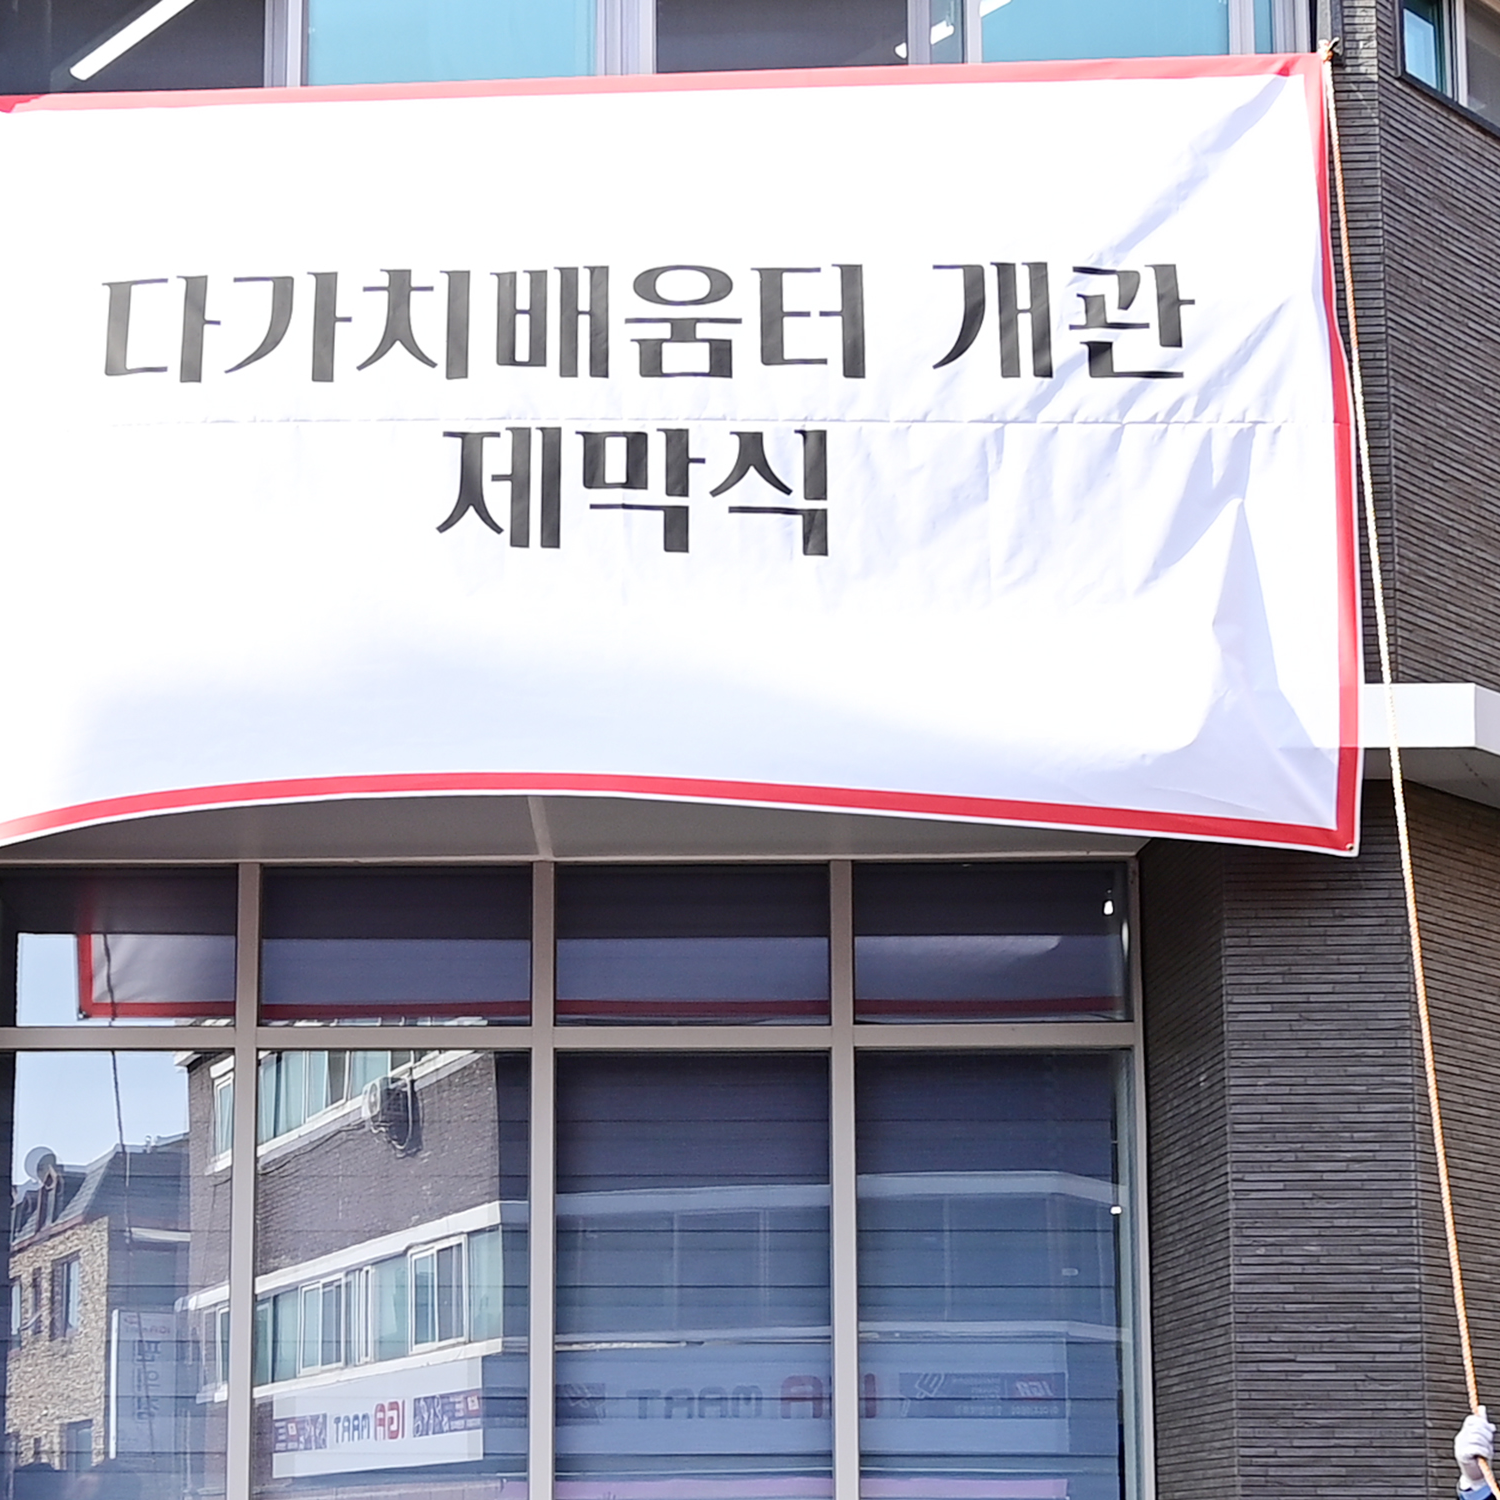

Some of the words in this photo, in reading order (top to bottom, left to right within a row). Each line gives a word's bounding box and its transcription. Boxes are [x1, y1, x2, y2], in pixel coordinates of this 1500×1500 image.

[102, 265, 865, 382] 다가치배움터
[933, 262, 1195, 379] 개관
[437, 427, 828, 556] 제막식
